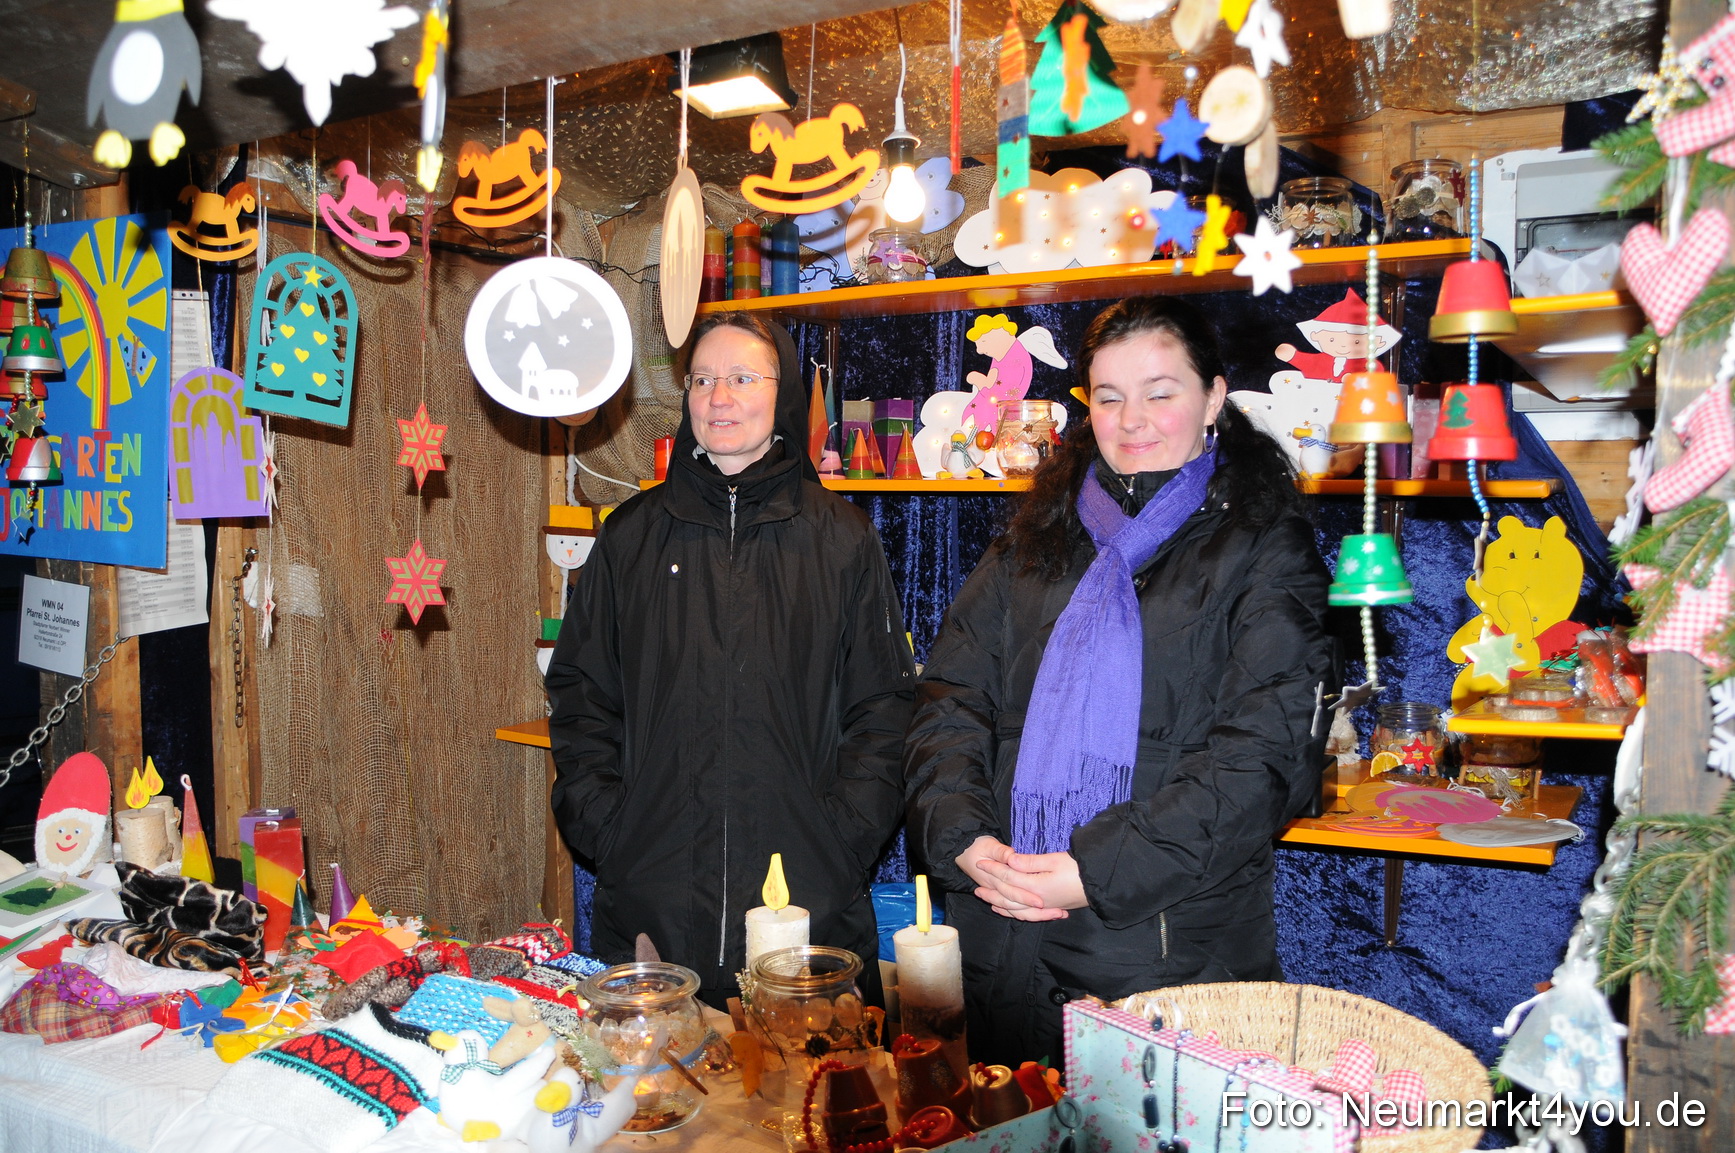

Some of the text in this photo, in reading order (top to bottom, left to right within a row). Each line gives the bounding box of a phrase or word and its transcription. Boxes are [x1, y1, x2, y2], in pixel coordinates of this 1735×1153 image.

[0, 487, 133, 542] JOHANNES
[42, 599, 64, 611] WMN 04
[27, 608, 43, 619] Pfarrei
[52, 614, 80, 627] Johannes
